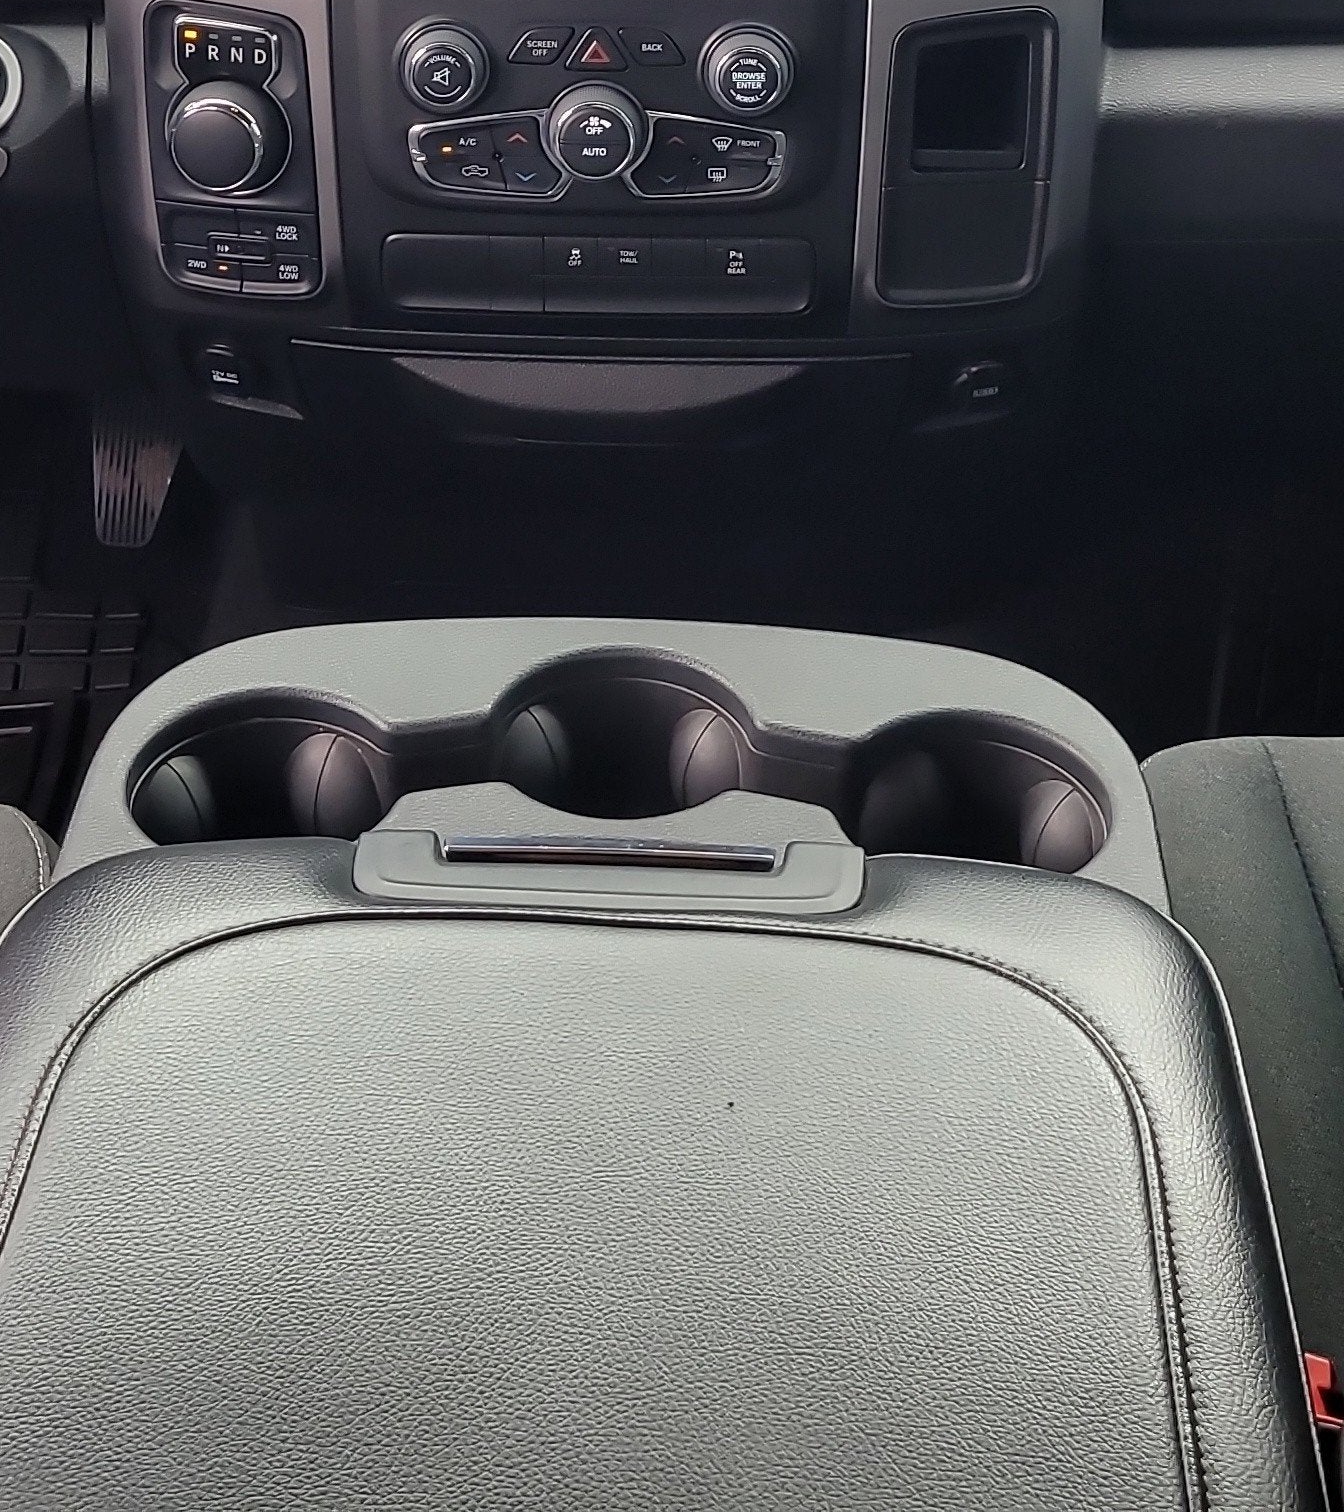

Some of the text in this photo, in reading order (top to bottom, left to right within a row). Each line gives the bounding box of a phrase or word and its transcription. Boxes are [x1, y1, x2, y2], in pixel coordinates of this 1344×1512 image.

[526, 40, 558, 48] SCREEN
[641, 43, 663, 52] BACK
[185, 42, 267, 65] P R N D
[429, 55, 456, 64] VOLUME
[732, 72, 766, 80] BROWSE
[736, 81, 762, 90] ENTER
[735, 93, 761, 103] SCROLL
[586, 127, 604, 135] OFF
[459, 138, 477, 146] A/C
[737, 139, 761, 148] FRONT
[582, 147, 607, 157] AUTO
[276, 225, 297, 233] 4WD
[276, 233, 298, 241] LOCK
[187, 259, 207, 269] 2WD
[568, 259, 582, 267] OFF
[279, 264, 299, 273] 4WD
[279, 272, 299, 280] LOW
